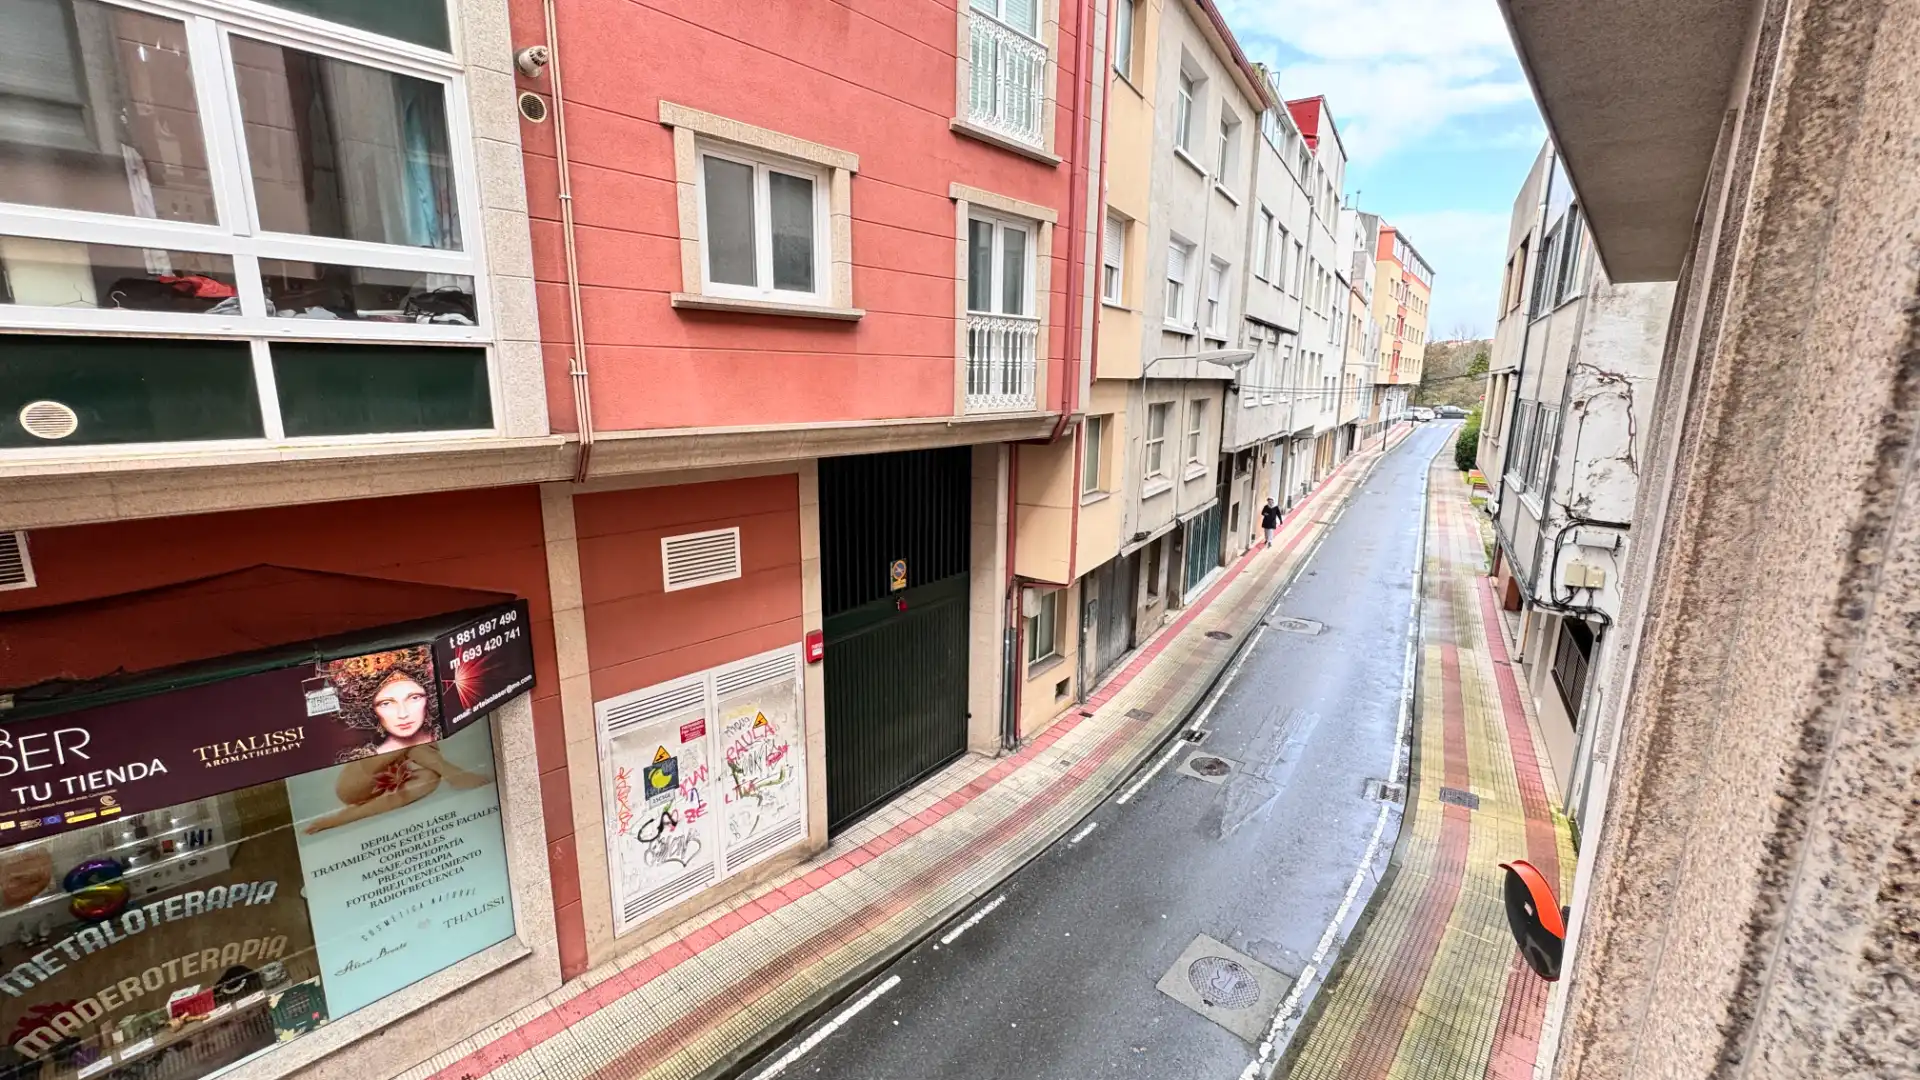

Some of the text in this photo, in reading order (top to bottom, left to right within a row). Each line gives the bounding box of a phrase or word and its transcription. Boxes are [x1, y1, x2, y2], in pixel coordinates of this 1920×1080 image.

[449, 610, 517, 649] t 881 897 490
[449, 626, 520, 670] m 693 420 741
[192, 726, 306, 762] THALISSI
[204, 741, 302, 769] AROMATHERAPY
[11, 781, 52, 805] TU
[59, 758, 168, 795] TIENDA
[311, 805, 500, 879] TRATAMIENTOS ESTÉTICOS FACIALES
[361, 810, 457, 851] DEPILACIÓN LÁSER
[379, 834, 446, 864] CORPORALES
[345, 849, 482, 909] FOTORREJUVENECIMIENTO
[361, 837, 465, 882] MASAJE-OSTEOPATÍA
[377, 851, 453, 886] PRESOTERAPIA
[369, 866, 465, 909] RADIOFRECUENCIA
[442, 895, 505, 929] THALISSI
[0, 880, 278, 997] METALOTERAPIA
[14, 934, 289, 1060] MADEROTERAPIA
